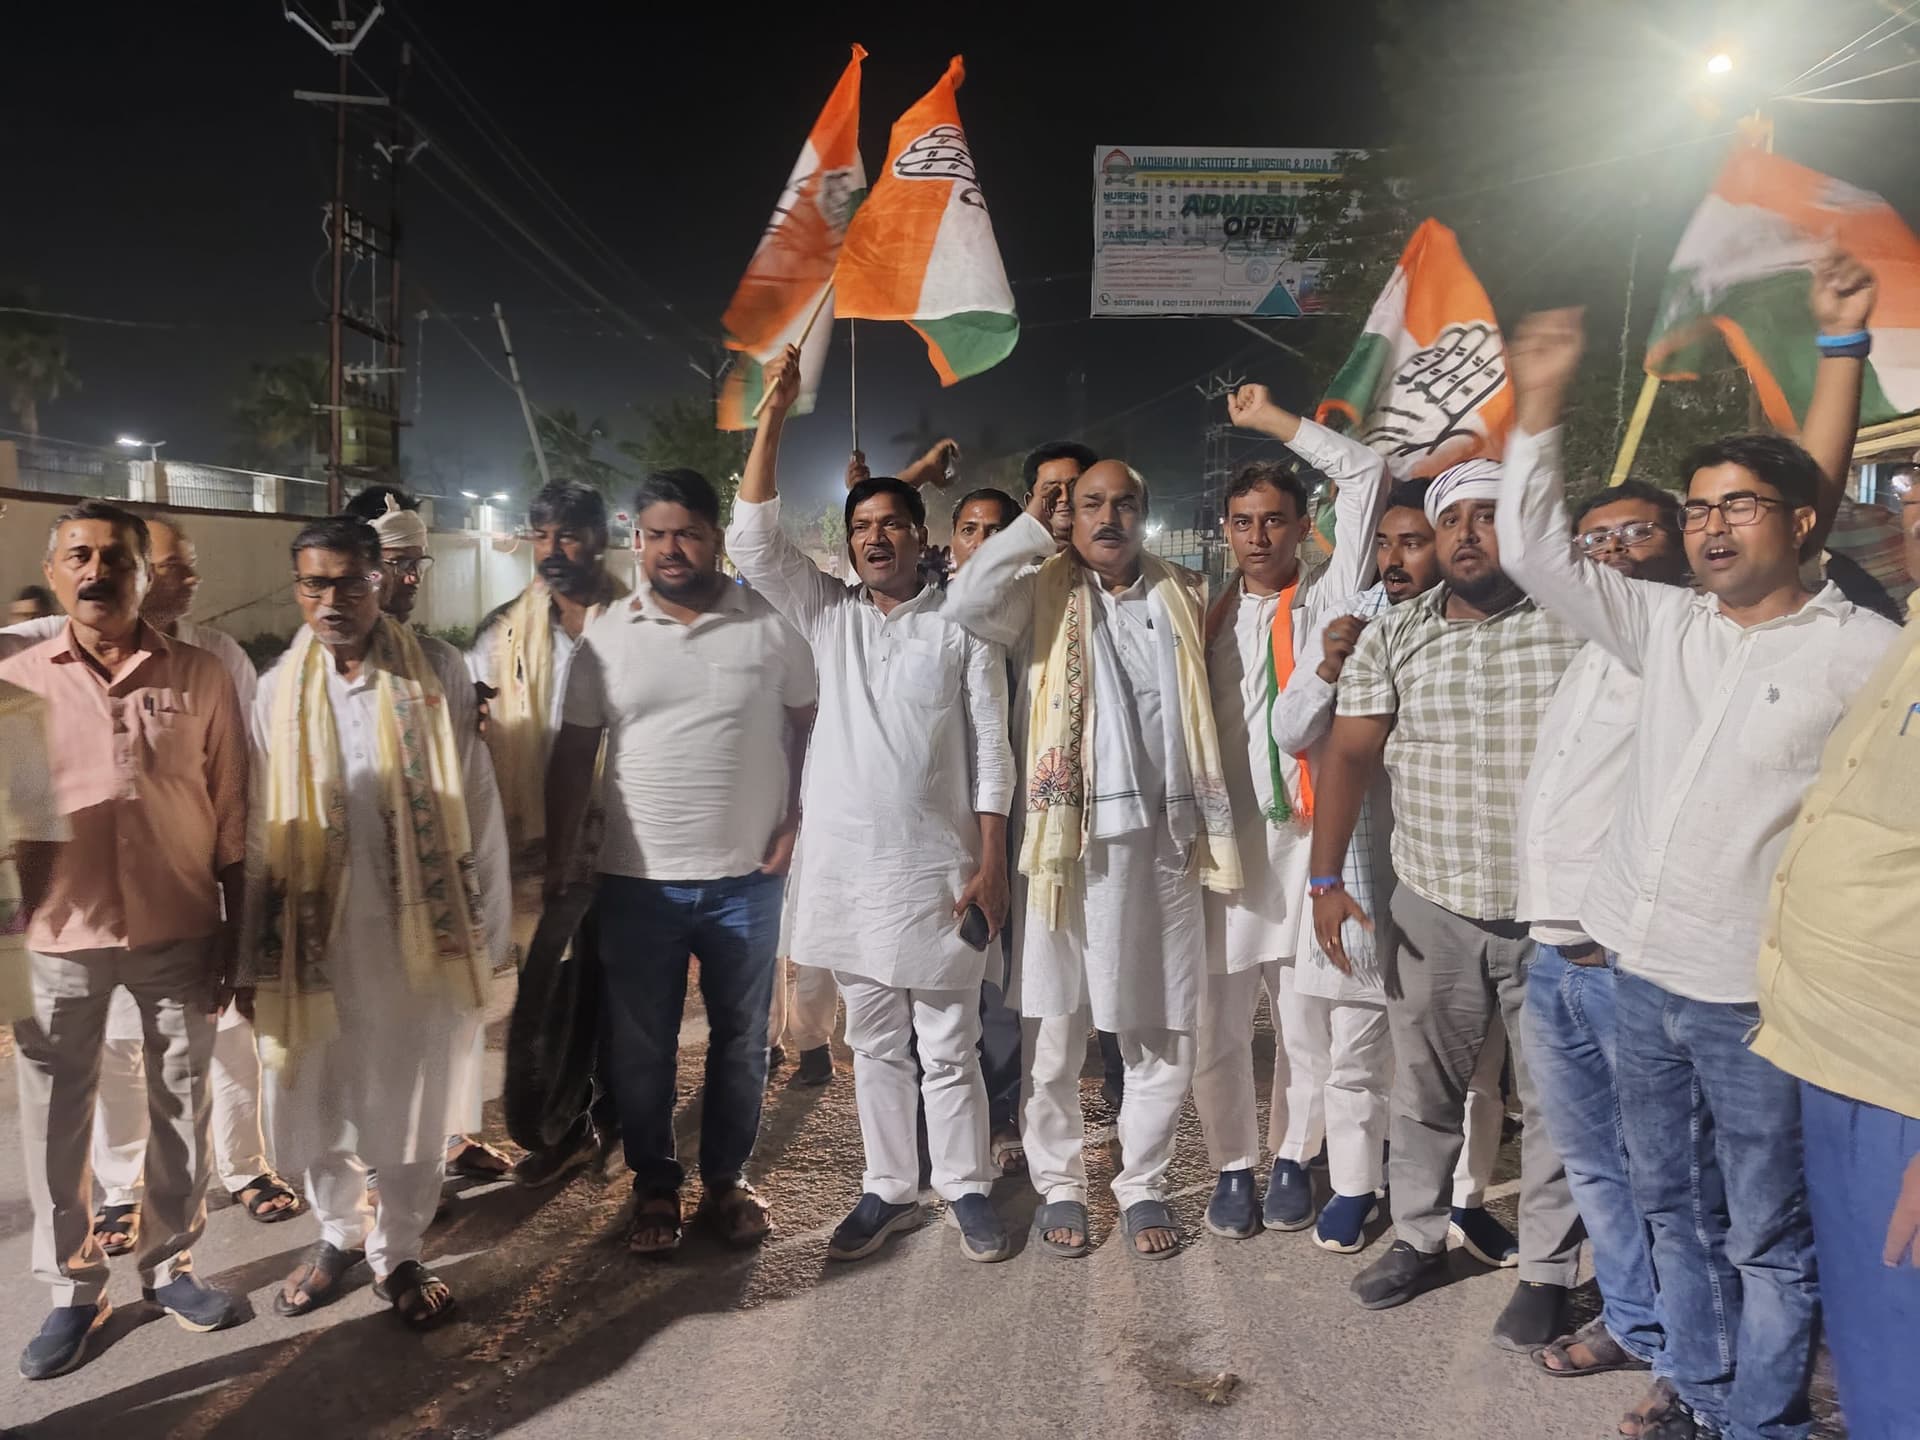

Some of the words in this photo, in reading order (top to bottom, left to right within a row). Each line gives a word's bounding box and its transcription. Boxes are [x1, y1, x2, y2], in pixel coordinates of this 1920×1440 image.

[1191, 156, 1236, 170] INSTITUTE
[1252, 158, 1291, 170] NURSING
[1303, 158, 1329, 170] PARA
[1103, 191, 1148, 200] NURSING
[1181, 193, 1298, 218] ADMISSI
[1223, 216, 1299, 237] OPEN
